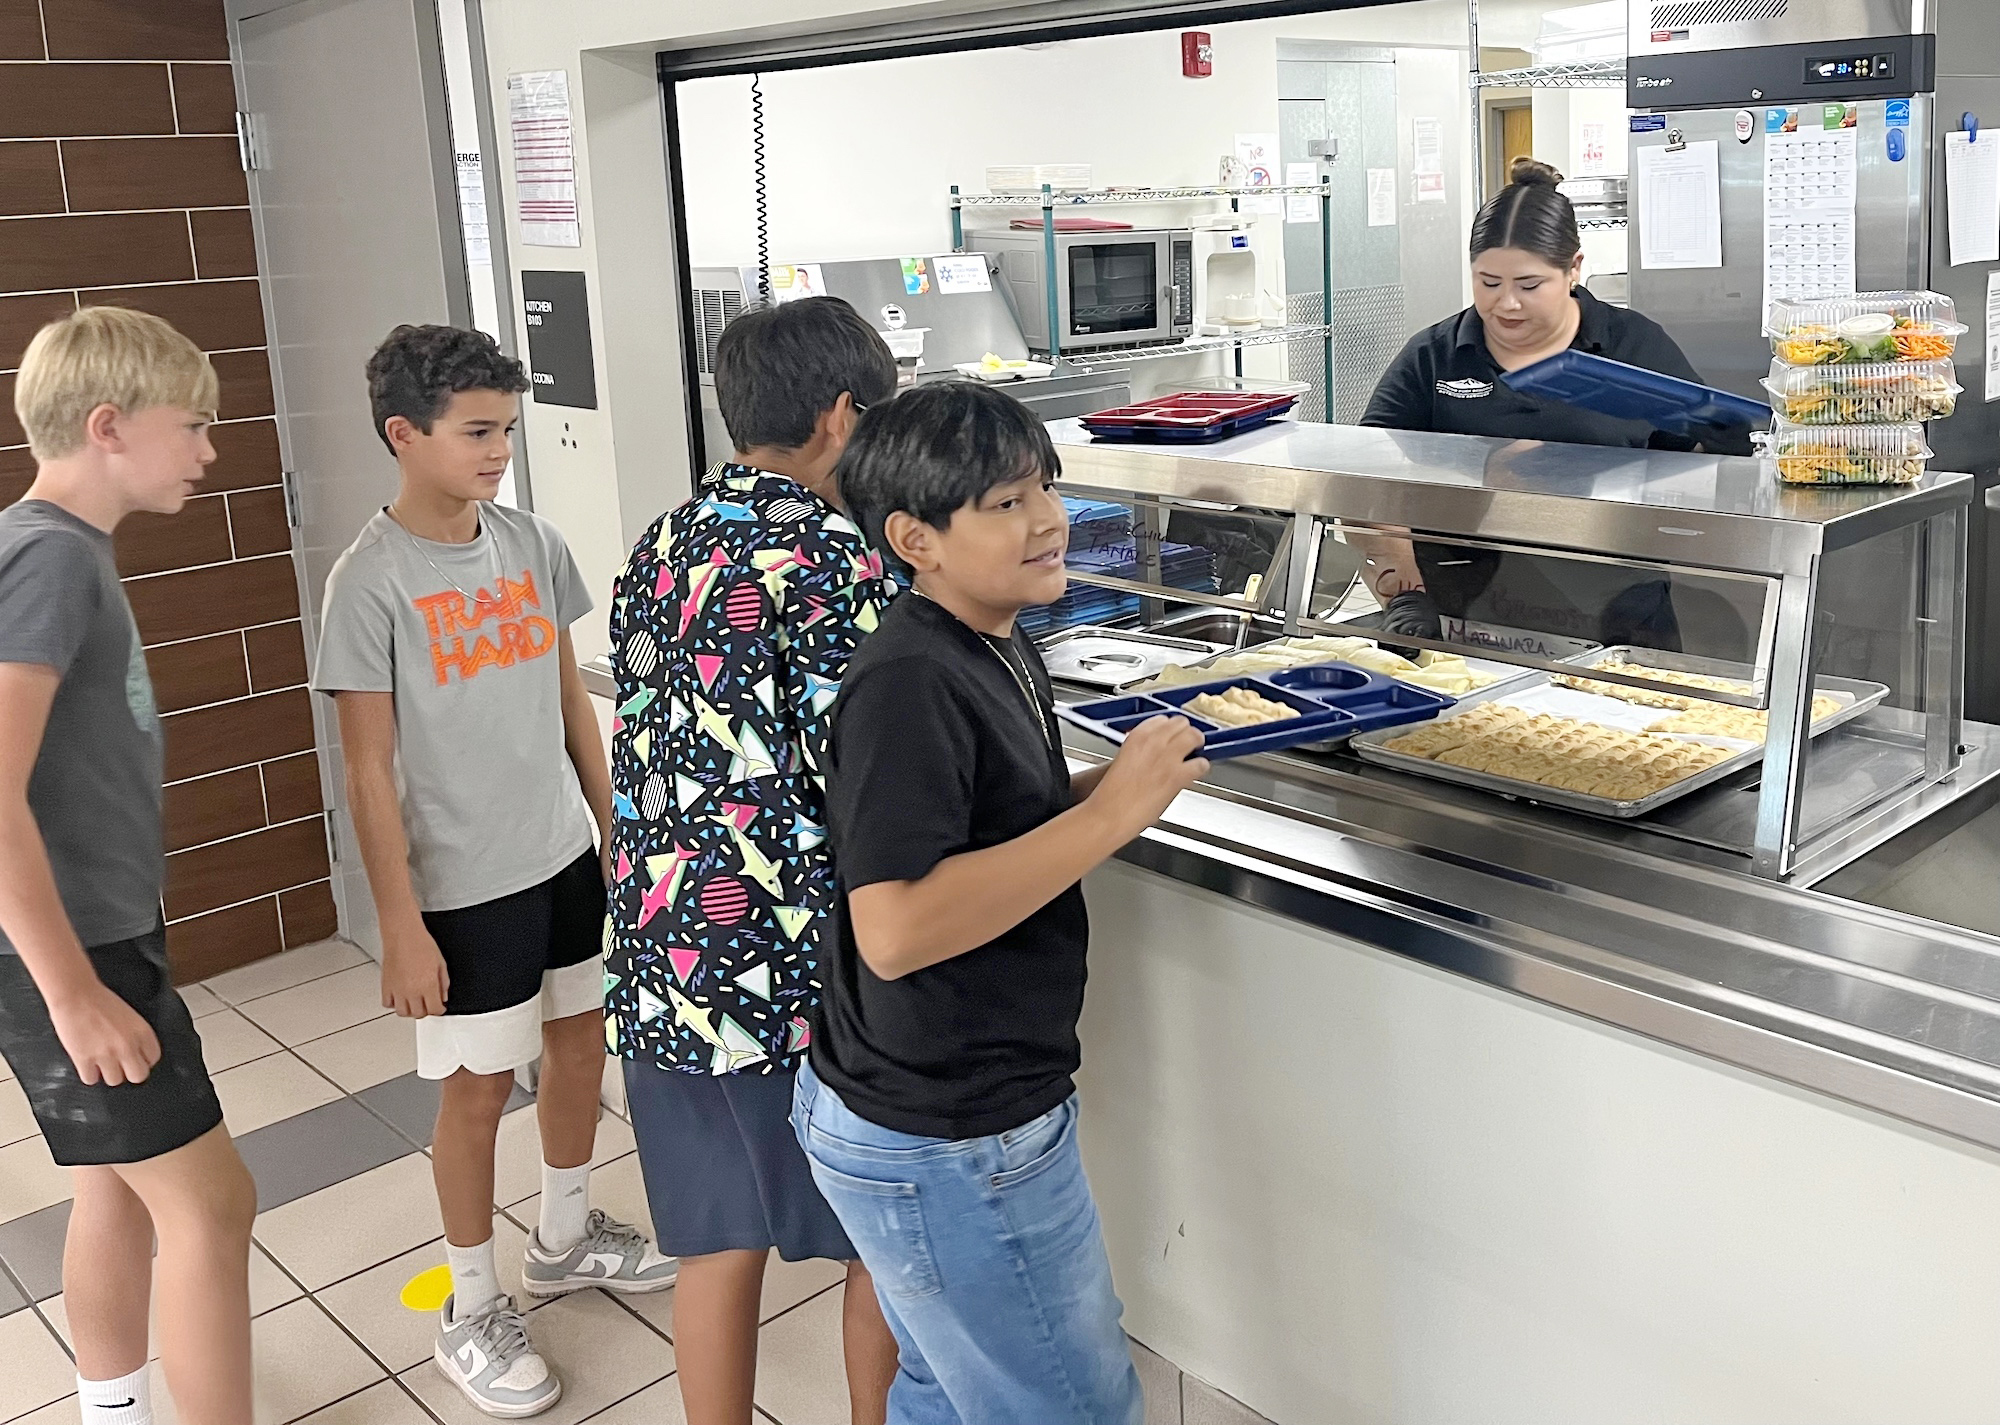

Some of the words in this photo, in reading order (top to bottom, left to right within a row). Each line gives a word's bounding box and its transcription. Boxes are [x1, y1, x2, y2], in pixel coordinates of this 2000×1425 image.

[525, 300, 552, 312] KITCHEN
[527, 314, 542, 326] B103
[533, 372, 554, 385] COCINA
[412, 569, 541, 640] TRAIN
[430, 615, 556, 687] HARD
